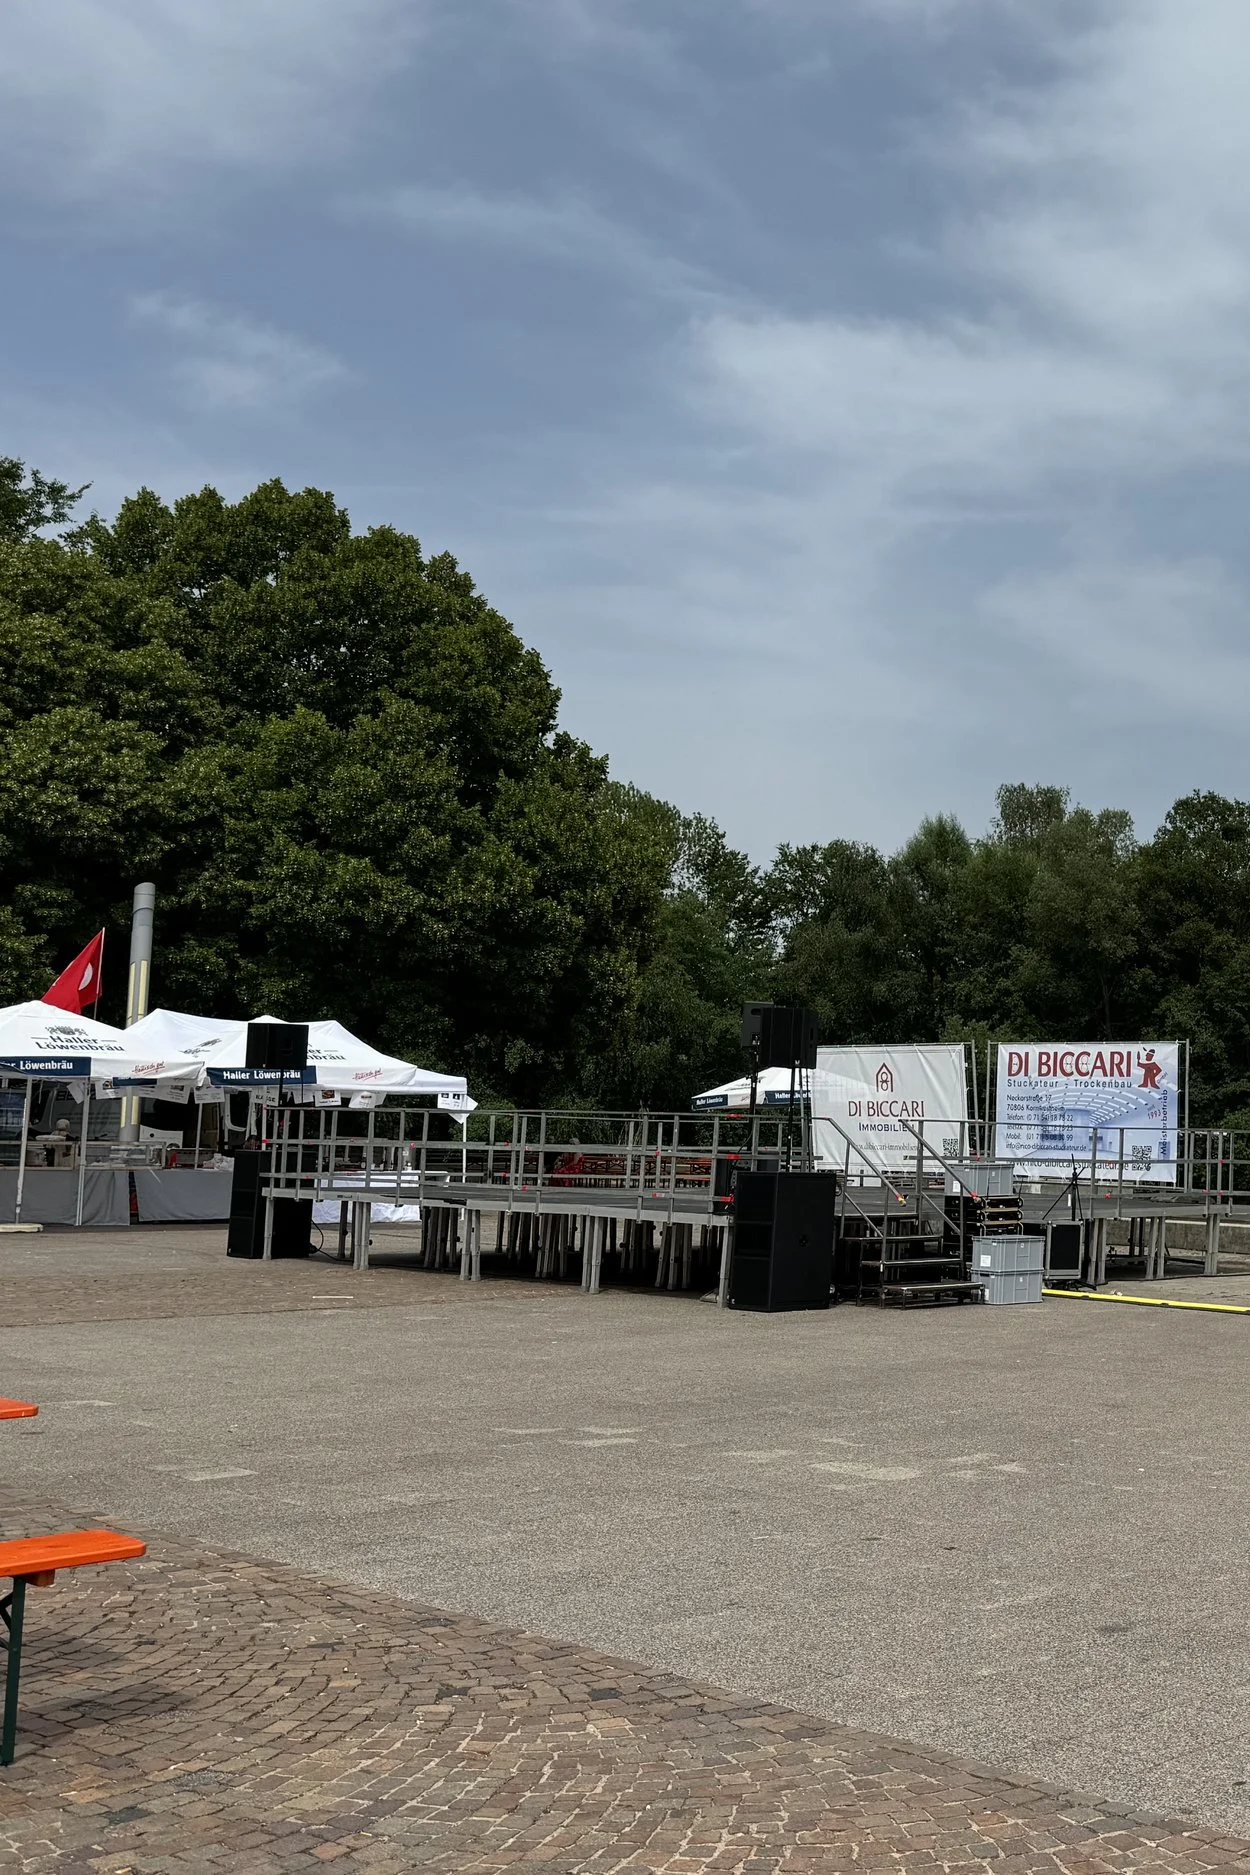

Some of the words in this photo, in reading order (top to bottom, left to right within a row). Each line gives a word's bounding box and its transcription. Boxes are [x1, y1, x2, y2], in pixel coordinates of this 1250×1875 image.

[49, 1035, 98, 1044] Haller
[35, 1041, 125, 1052] Löwenbräu
[20, 1060, 73, 1070] Löwenbräu
[1007, 1051, 1029, 1077] DI
[1037, 1050, 1132, 1078] BICCARI
[223, 1070, 250, 1080] Haller
[1007, 1078, 1059, 1088] Stuckateur
[1074, 1079, 1132, 1088] Trockenbau
[848, 1101, 861, 1117] DI
[867, 1100, 925, 1117] BICCARI
[1006, 1103, 1024, 1111] 70806
[1147, 1109, 1162, 1120] 1993
